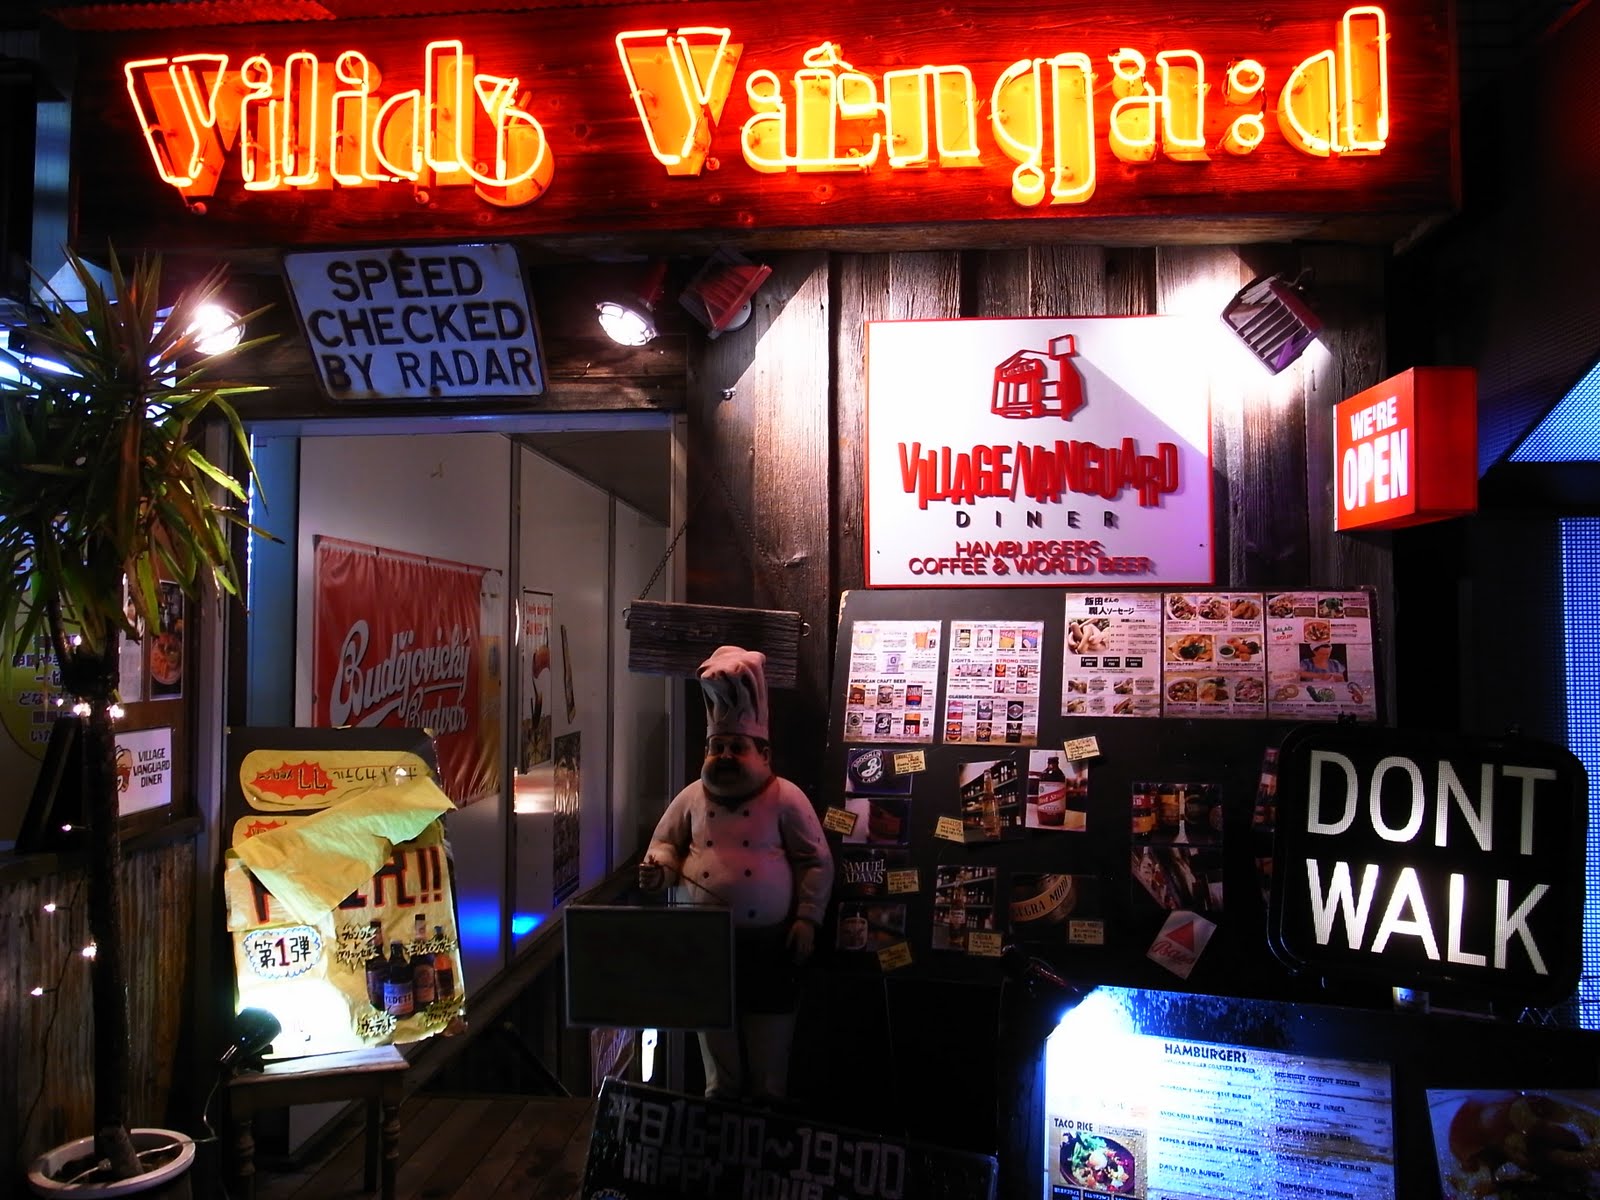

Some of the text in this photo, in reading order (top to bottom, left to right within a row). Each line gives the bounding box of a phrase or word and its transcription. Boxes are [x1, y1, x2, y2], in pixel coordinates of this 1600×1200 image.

[328, 257, 483, 300] SPEED
[308, 299, 526, 347] CHECKED
[327, 346, 536, 393] BY RADAR
[1351, 396, 1398, 442] WE'RE
[1343, 428, 1409, 511] OPEN
[956, 510, 1118, 529] DINER
[956, 540, 1105, 559] HAMBURGERS
[909, 556, 1155, 576] COFFEE & WORLD BEER
[1272, 626, 1293, 634] SALAD
[138, 748, 166, 762] VILLAGE
[132, 760, 171, 777] VANGUARD
[140, 774, 163, 788] DINER
[1307, 750, 1557, 855] DONT
[841, 858, 888, 873] SAMUEL
[845, 871, 884, 885] ADAMS
[1306, 858, 1551, 976] WALK
[254, 937, 311, 967] 第1弾
[1164, 1042, 1248, 1064] HAMBURGERS
[1234, 1066, 1256, 1074] BURGER
[1335, 1079, 1361, 1088] BURGER
[1053, 1117, 1094, 1132] TACO RICE
[1214, 1117, 1243, 1128] BURGER
[1159, 1163, 1179, 1172] DAILY
